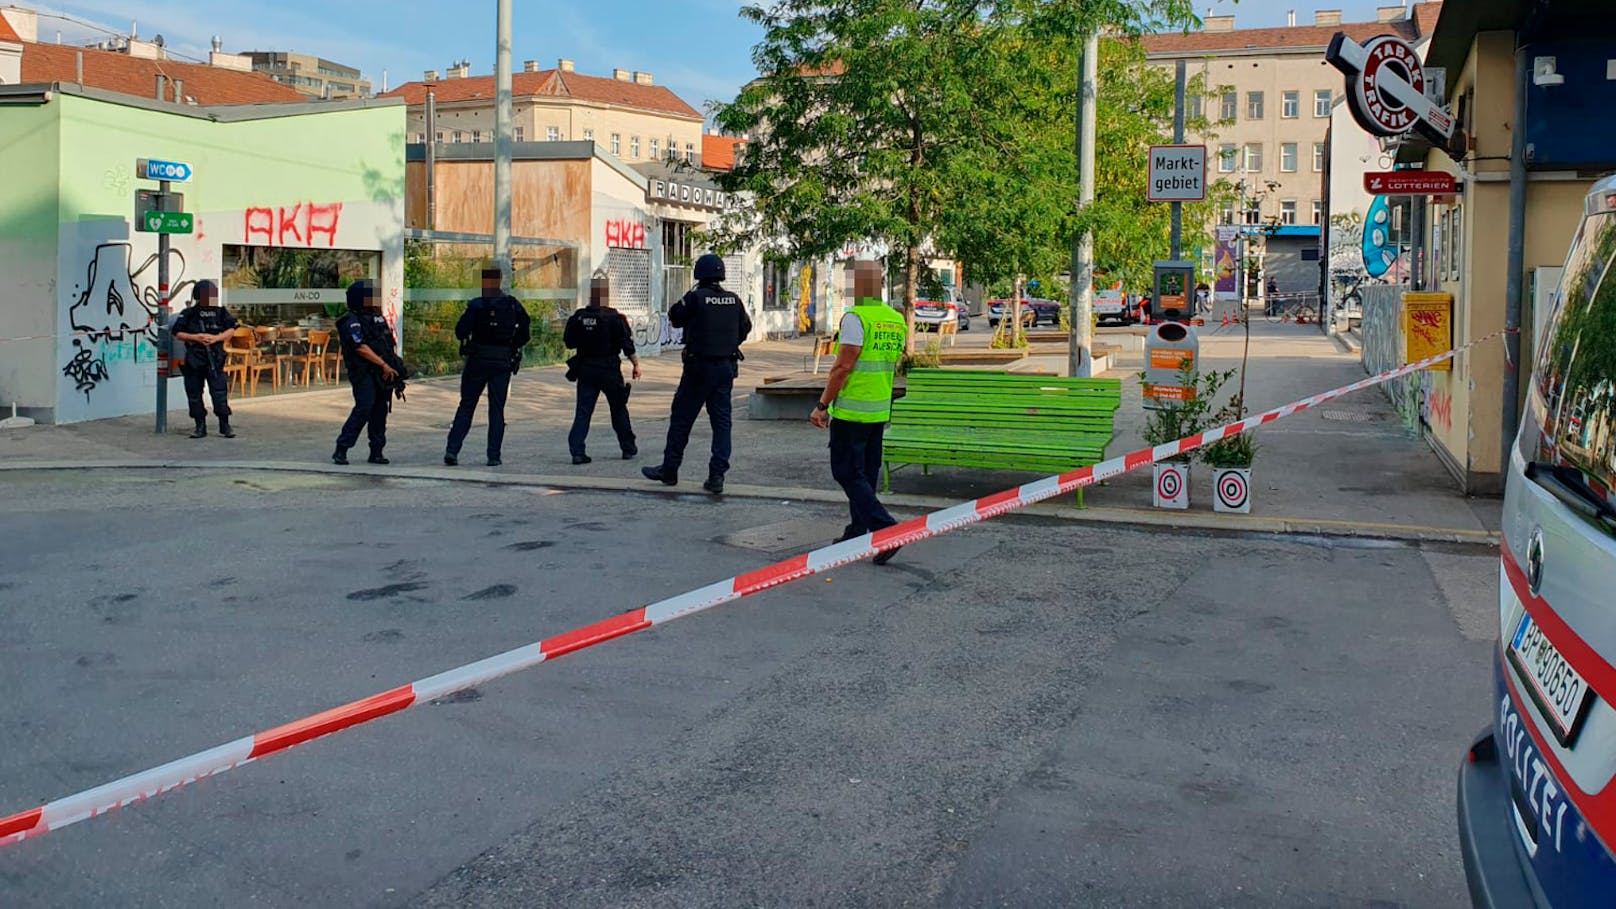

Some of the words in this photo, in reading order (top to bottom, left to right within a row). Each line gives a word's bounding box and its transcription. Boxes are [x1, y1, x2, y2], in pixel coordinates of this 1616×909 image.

[1373, 43, 1422, 82] TABAK
[1364, 74, 1410, 127] TRAFIK
[149, 162, 166, 176] WC
[1155, 156, 1200, 170] Markt-
[1155, 175, 1199, 193] gebiet
[1387, 182, 1450, 190] LOTTERIEN
[244, 201, 343, 247] AKA
[605, 216, 645, 249] AKA
[704, 296, 736, 305] POLIZEI
[1521, 622, 1542, 658] BP
[1537, 644, 1580, 717] 90650
[1500, 693, 1568, 854] POLIZEI
